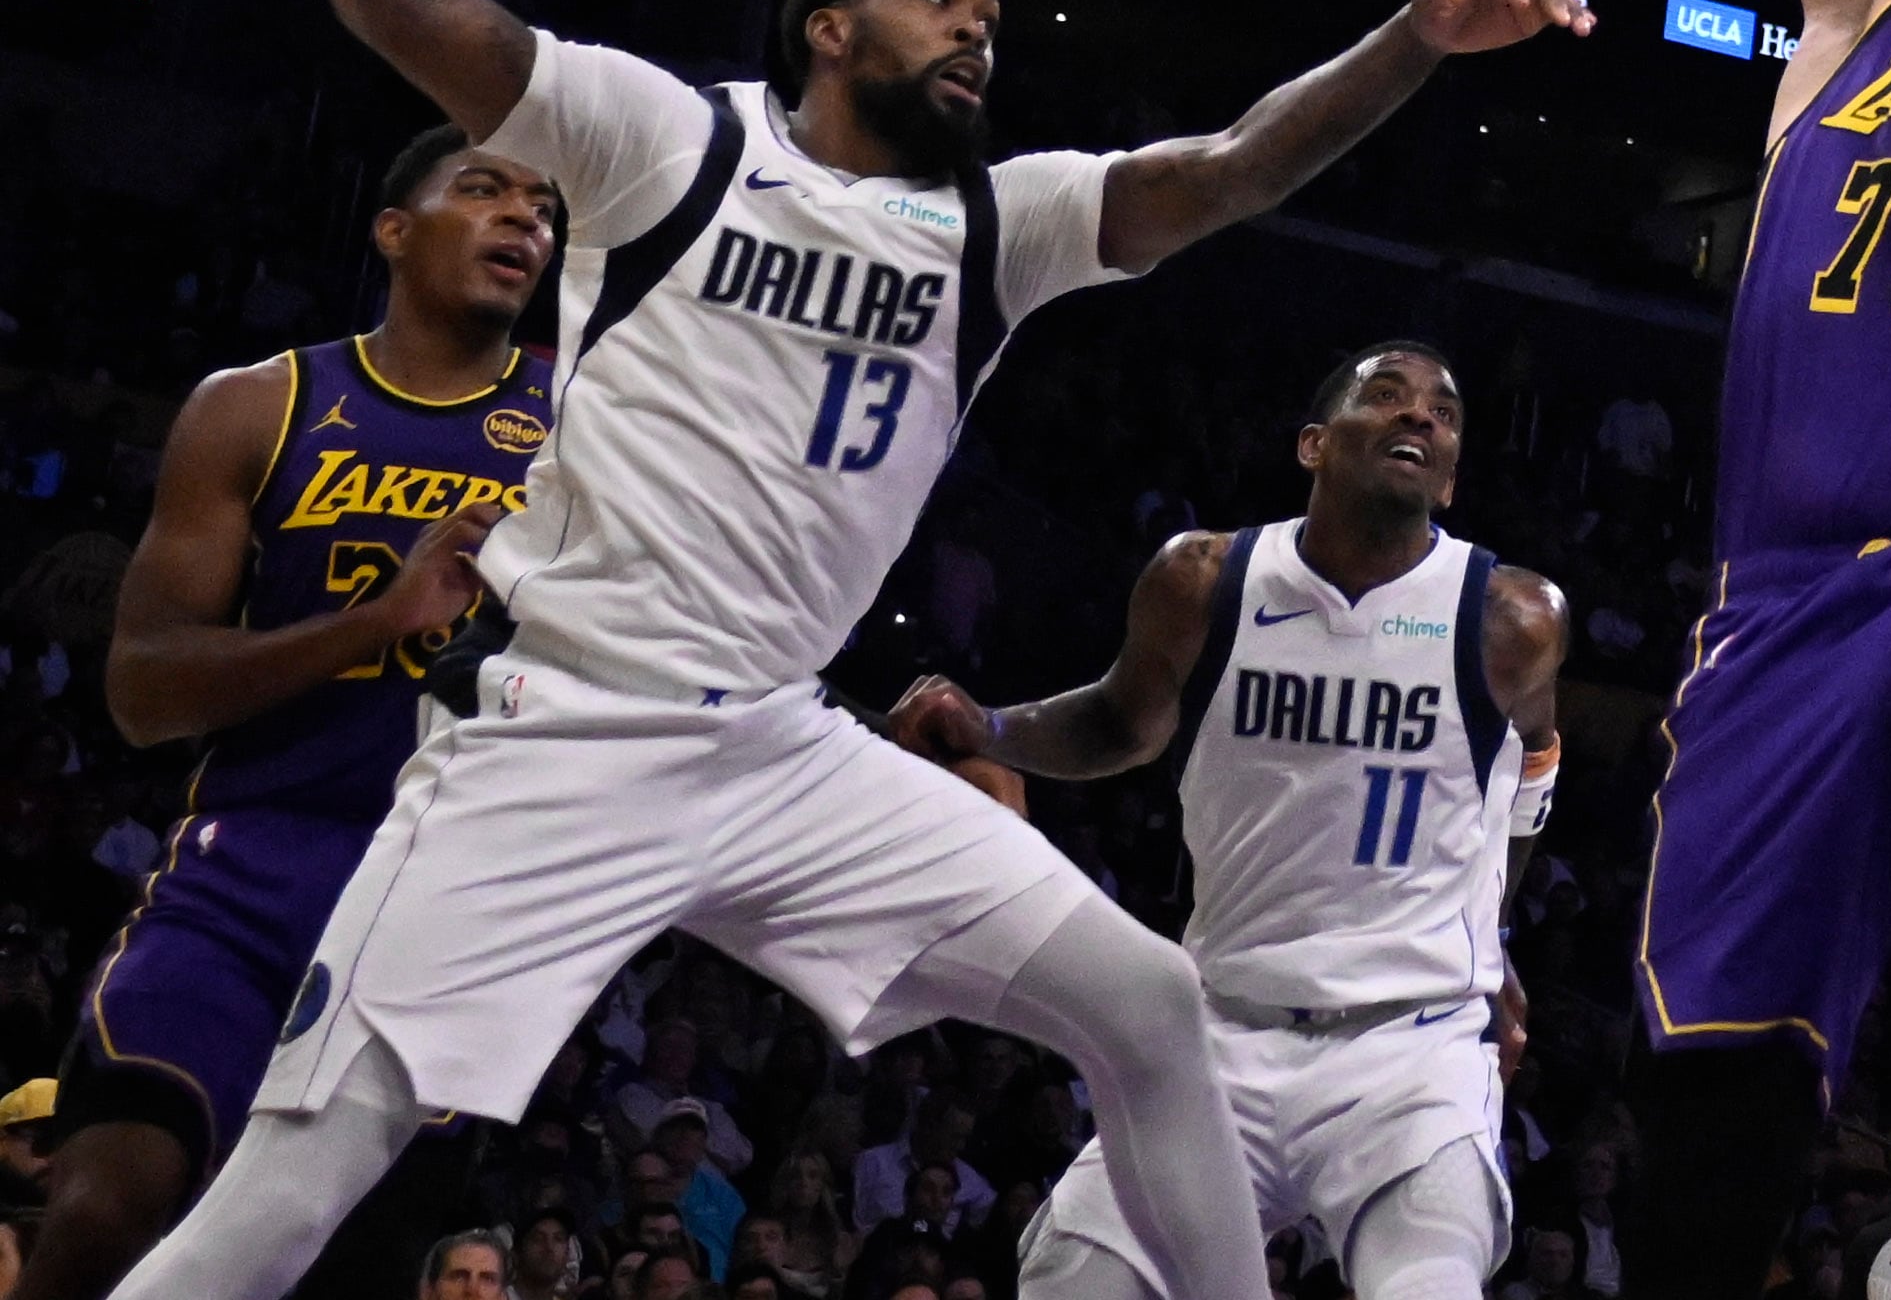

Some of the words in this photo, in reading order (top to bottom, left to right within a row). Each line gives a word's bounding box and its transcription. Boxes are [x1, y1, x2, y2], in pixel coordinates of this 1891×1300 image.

[1677, 6, 1742, 45] UCLA
[883, 194, 958, 231] chime
[699, 227, 948, 346] DALLAS
[806, 349, 912, 473] 13
[1380, 613, 1449, 640] chime
[1233, 668, 1441, 752] DALLAS
[1352, 766, 1427, 867] 11
